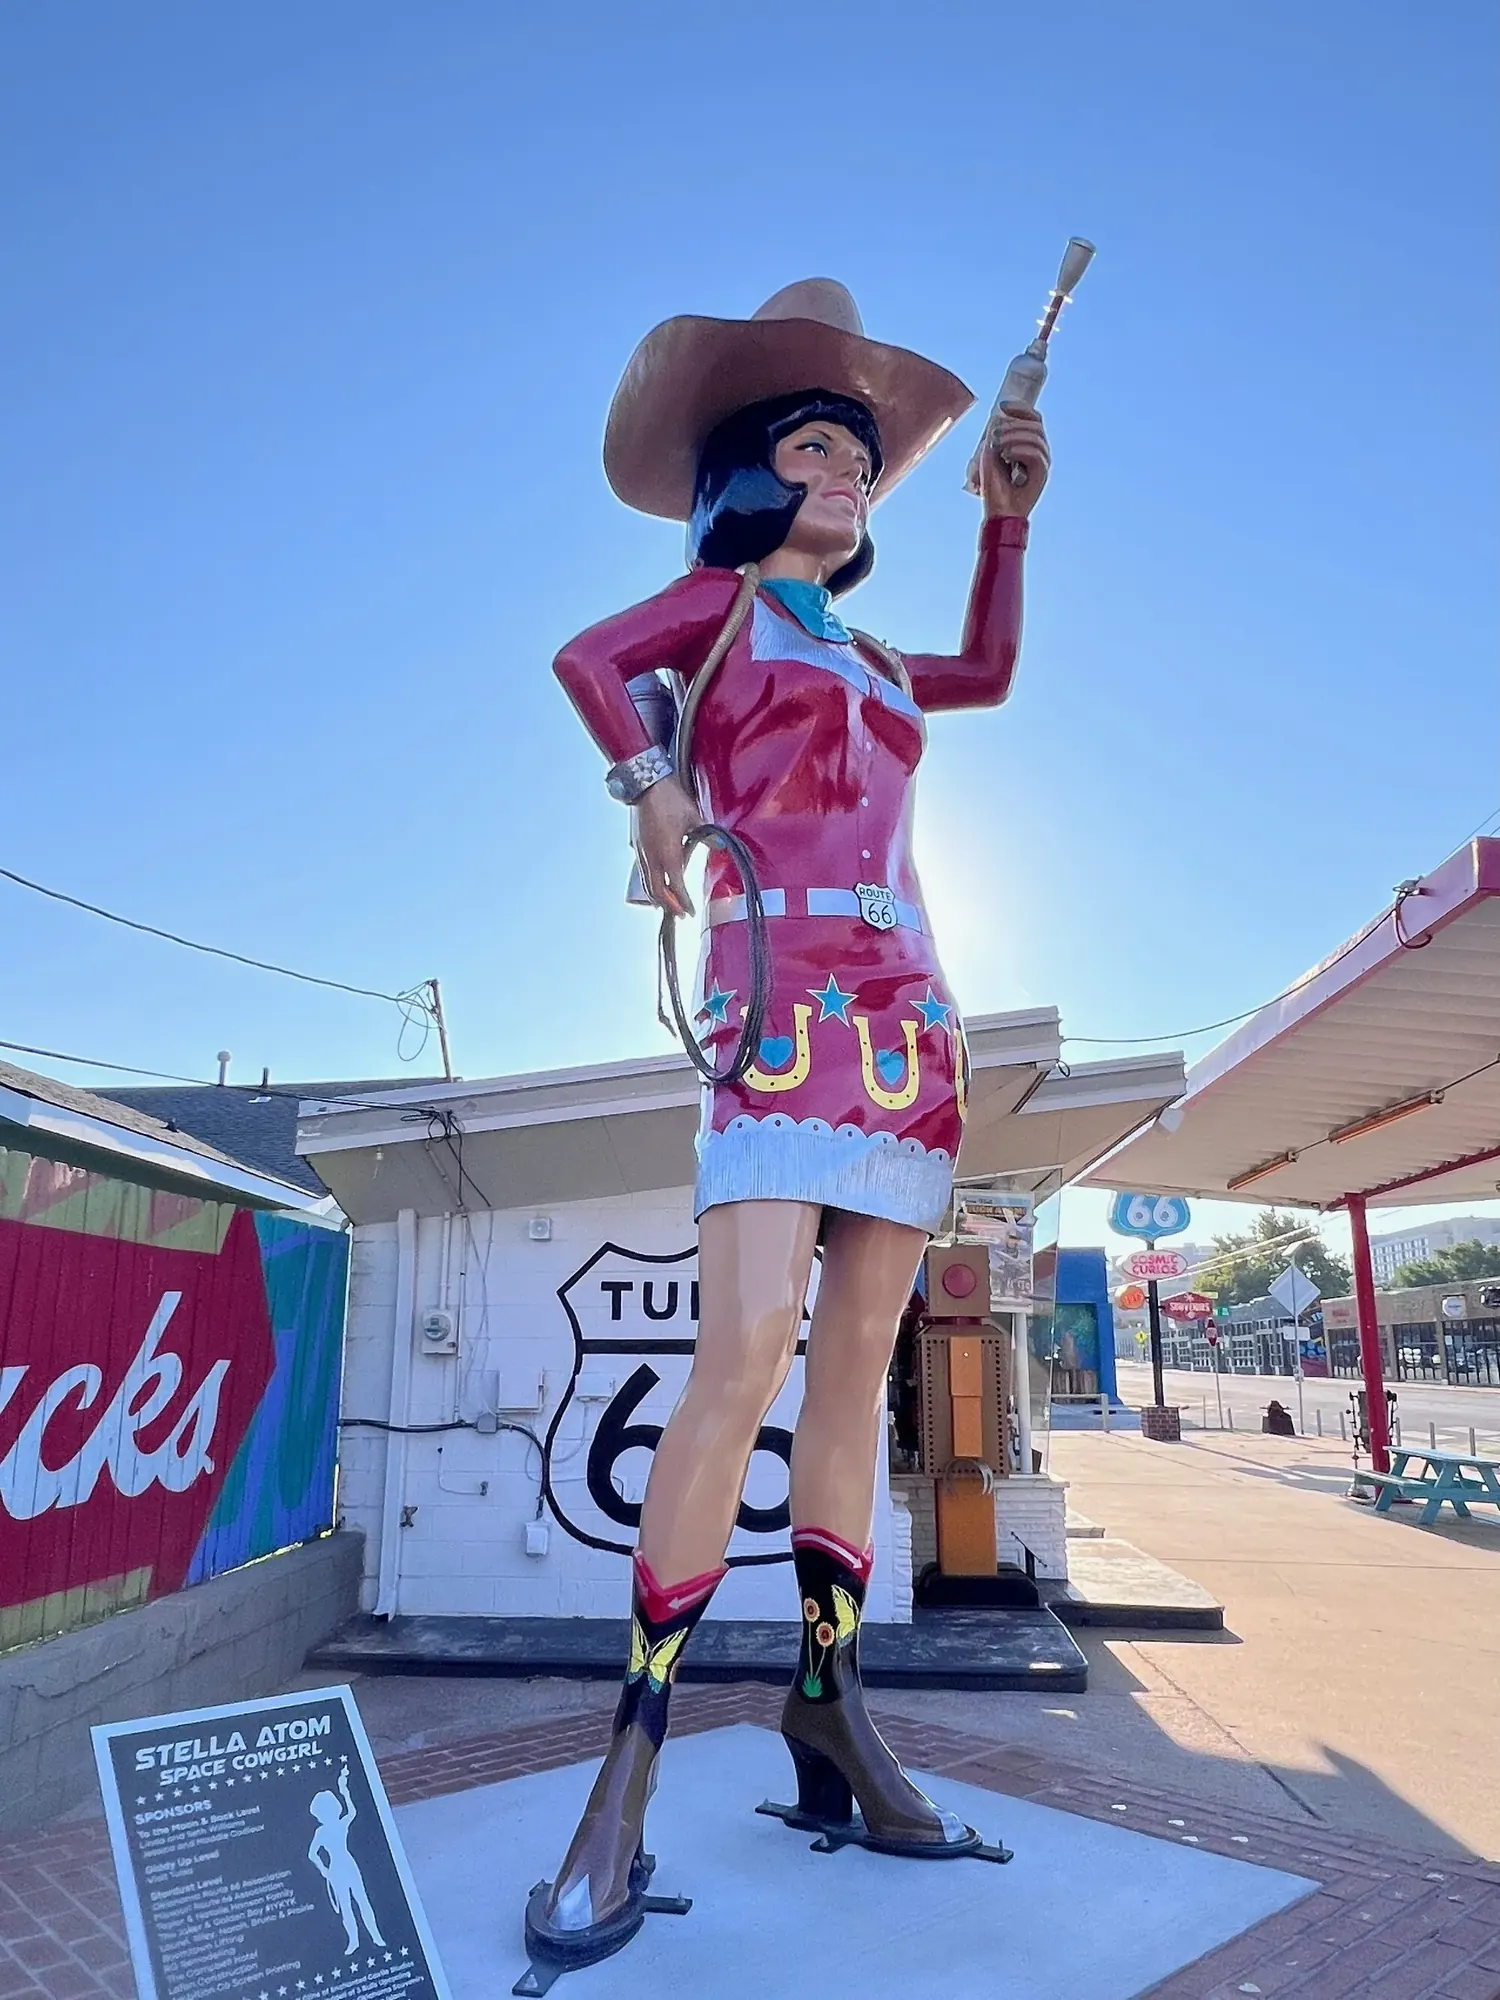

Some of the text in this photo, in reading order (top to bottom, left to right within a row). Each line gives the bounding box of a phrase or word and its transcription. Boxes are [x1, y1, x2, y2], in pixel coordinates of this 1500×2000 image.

[859, 887, 891, 901] ROUTE
[868, 902, 892, 925] 66
[1127, 1195, 1179, 1228] 66
[1131, 1254, 1178, 1264] COSMIC
[1132, 1264, 1178, 1275] CURIOS
[135, 1715, 331, 1771] STELLA ATOM
[159, 1740, 323, 1787] SPACE COWGIRL
[134, 1799, 212, 1825] SPONSORS
[171, 1820, 200, 1832] Moon
[200, 1817, 209, 1826] &
[210, 1811, 235, 1823] Back
[236, 1805, 261, 1818] Level
[193, 1849, 220, 1863] Level
[196, 1875, 224, 1889] Level
[242, 1870, 292, 1888] Association
[234, 1882, 285, 1900] Association
[265, 1889, 294, 1903] Family
[197, 1962, 259, 1986] Construction
[265, 1960, 301, 1976] Printing
